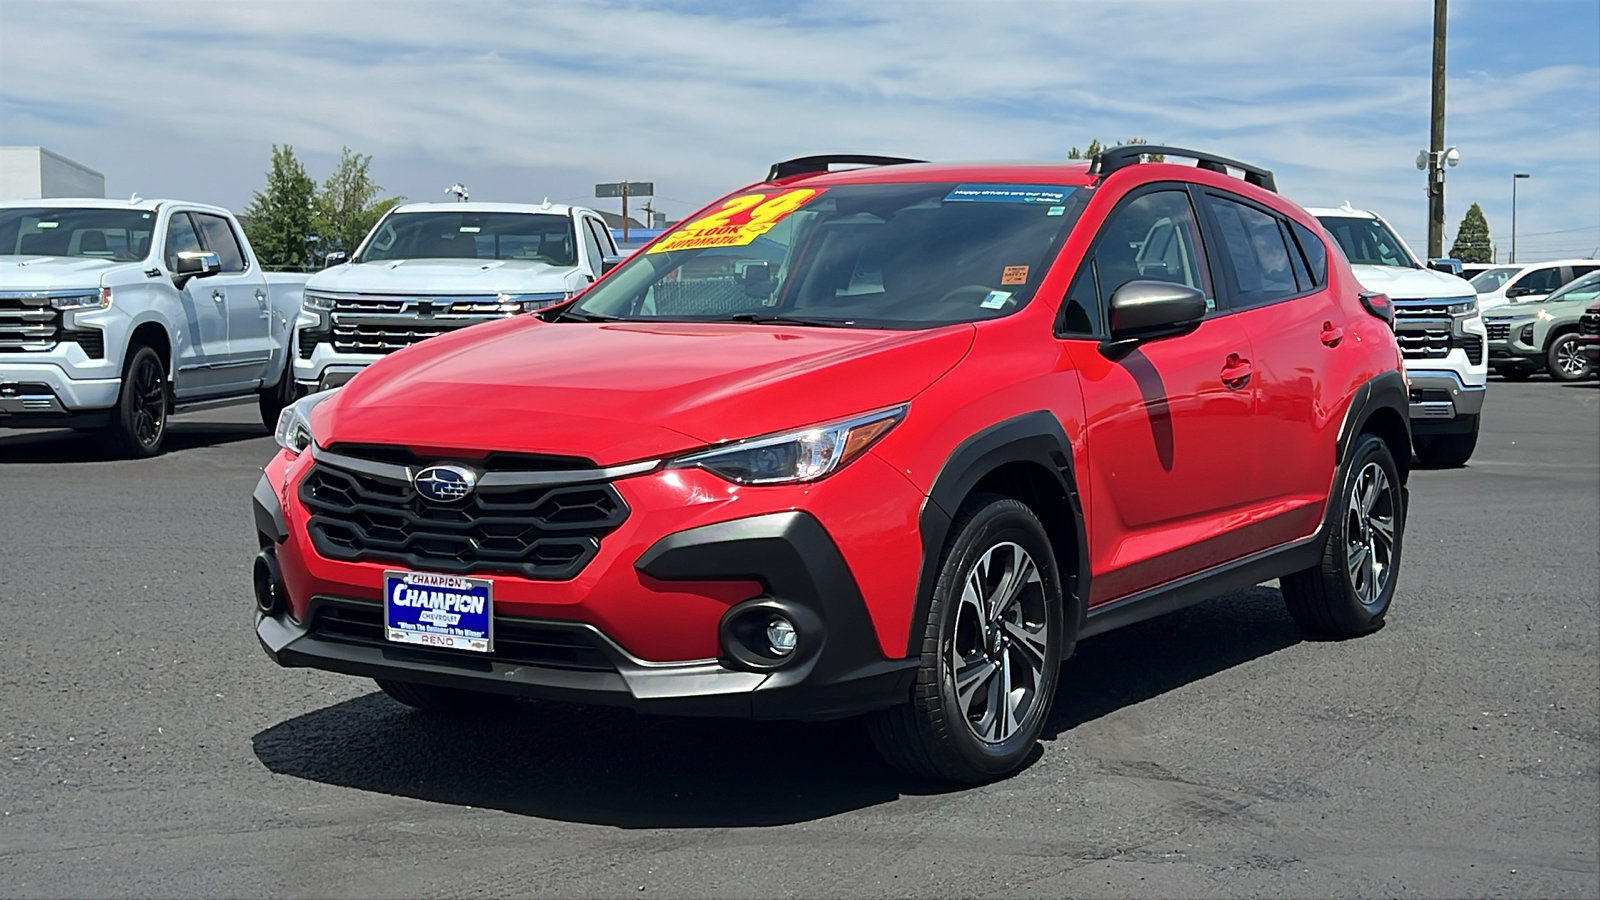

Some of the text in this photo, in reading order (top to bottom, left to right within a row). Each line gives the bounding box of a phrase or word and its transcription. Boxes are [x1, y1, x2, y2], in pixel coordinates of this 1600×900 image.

[684, 188, 817, 231] 24
[693, 225, 744, 238] LOOK
[661, 234, 744, 251] AUTOMATIC
[412, 574, 461, 588] CHAMPION
[393, 583, 485, 614] CHAMPION
[422, 612, 458, 622] CHEVROLET
[421, 635, 454, 646] RENO
